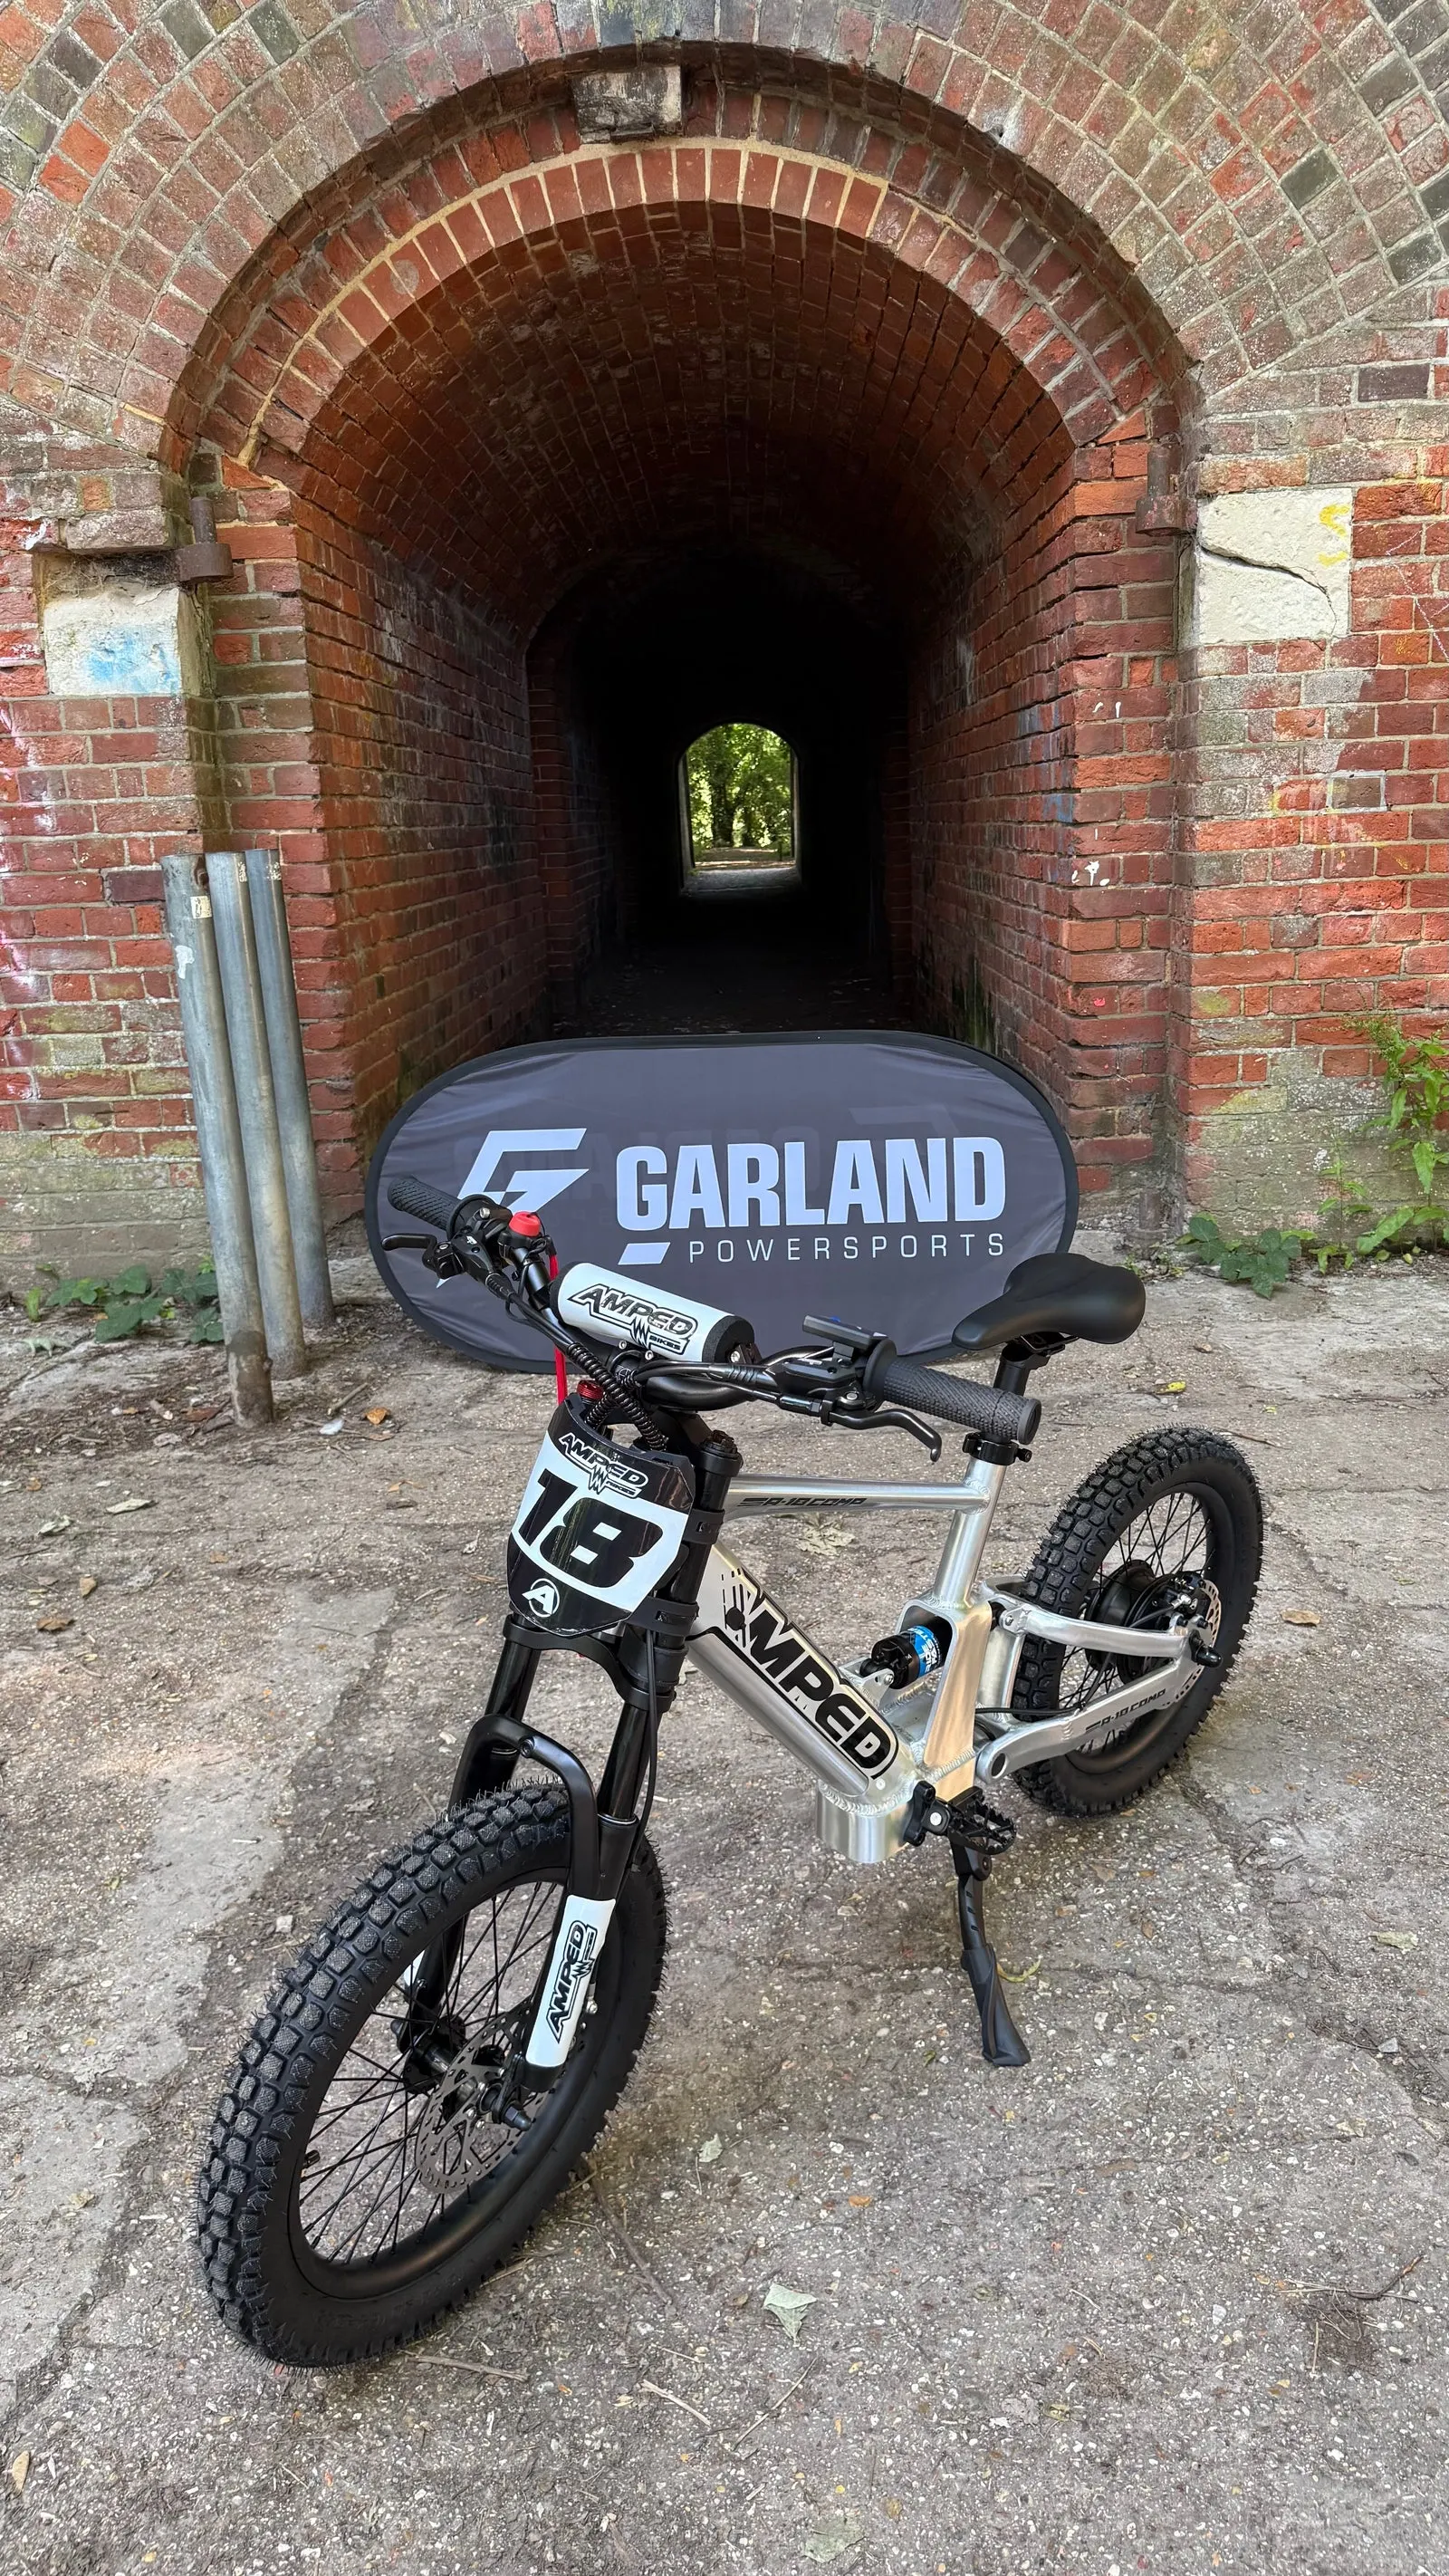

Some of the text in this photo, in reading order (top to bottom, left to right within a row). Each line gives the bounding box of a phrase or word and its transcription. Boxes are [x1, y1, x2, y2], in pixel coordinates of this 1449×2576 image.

[616, 1137, 1006, 1231] GARLAND
[690, 1233, 1004, 1264] POWERSPORTS
[572, 1285, 696, 1337] AMPED
[649, 1335, 680, 1350] BIKES
[560, 1434, 648, 1487] AMPED
[806, 1497, 868, 1506] COMP
[518, 1468, 663, 1589] 18
[730, 1583, 892, 1770] MPED
[548, 1922, 586, 2038] AMPED
